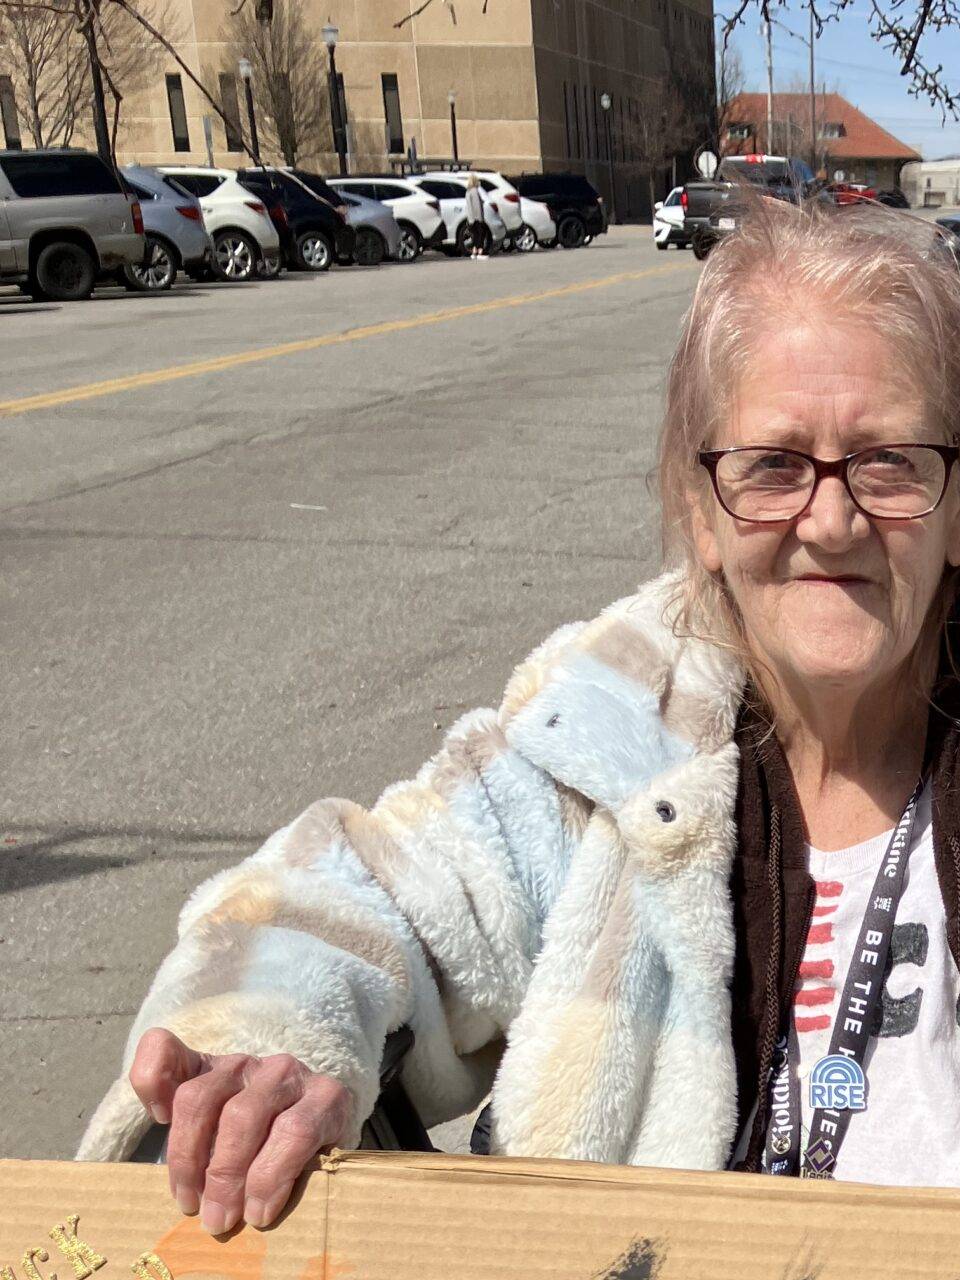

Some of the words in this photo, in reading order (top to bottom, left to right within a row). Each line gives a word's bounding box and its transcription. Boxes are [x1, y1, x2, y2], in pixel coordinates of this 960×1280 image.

[860, 929, 883, 966] BE
[843, 980, 872, 1035] THE
[811, 1085, 865, 1109] RISE
